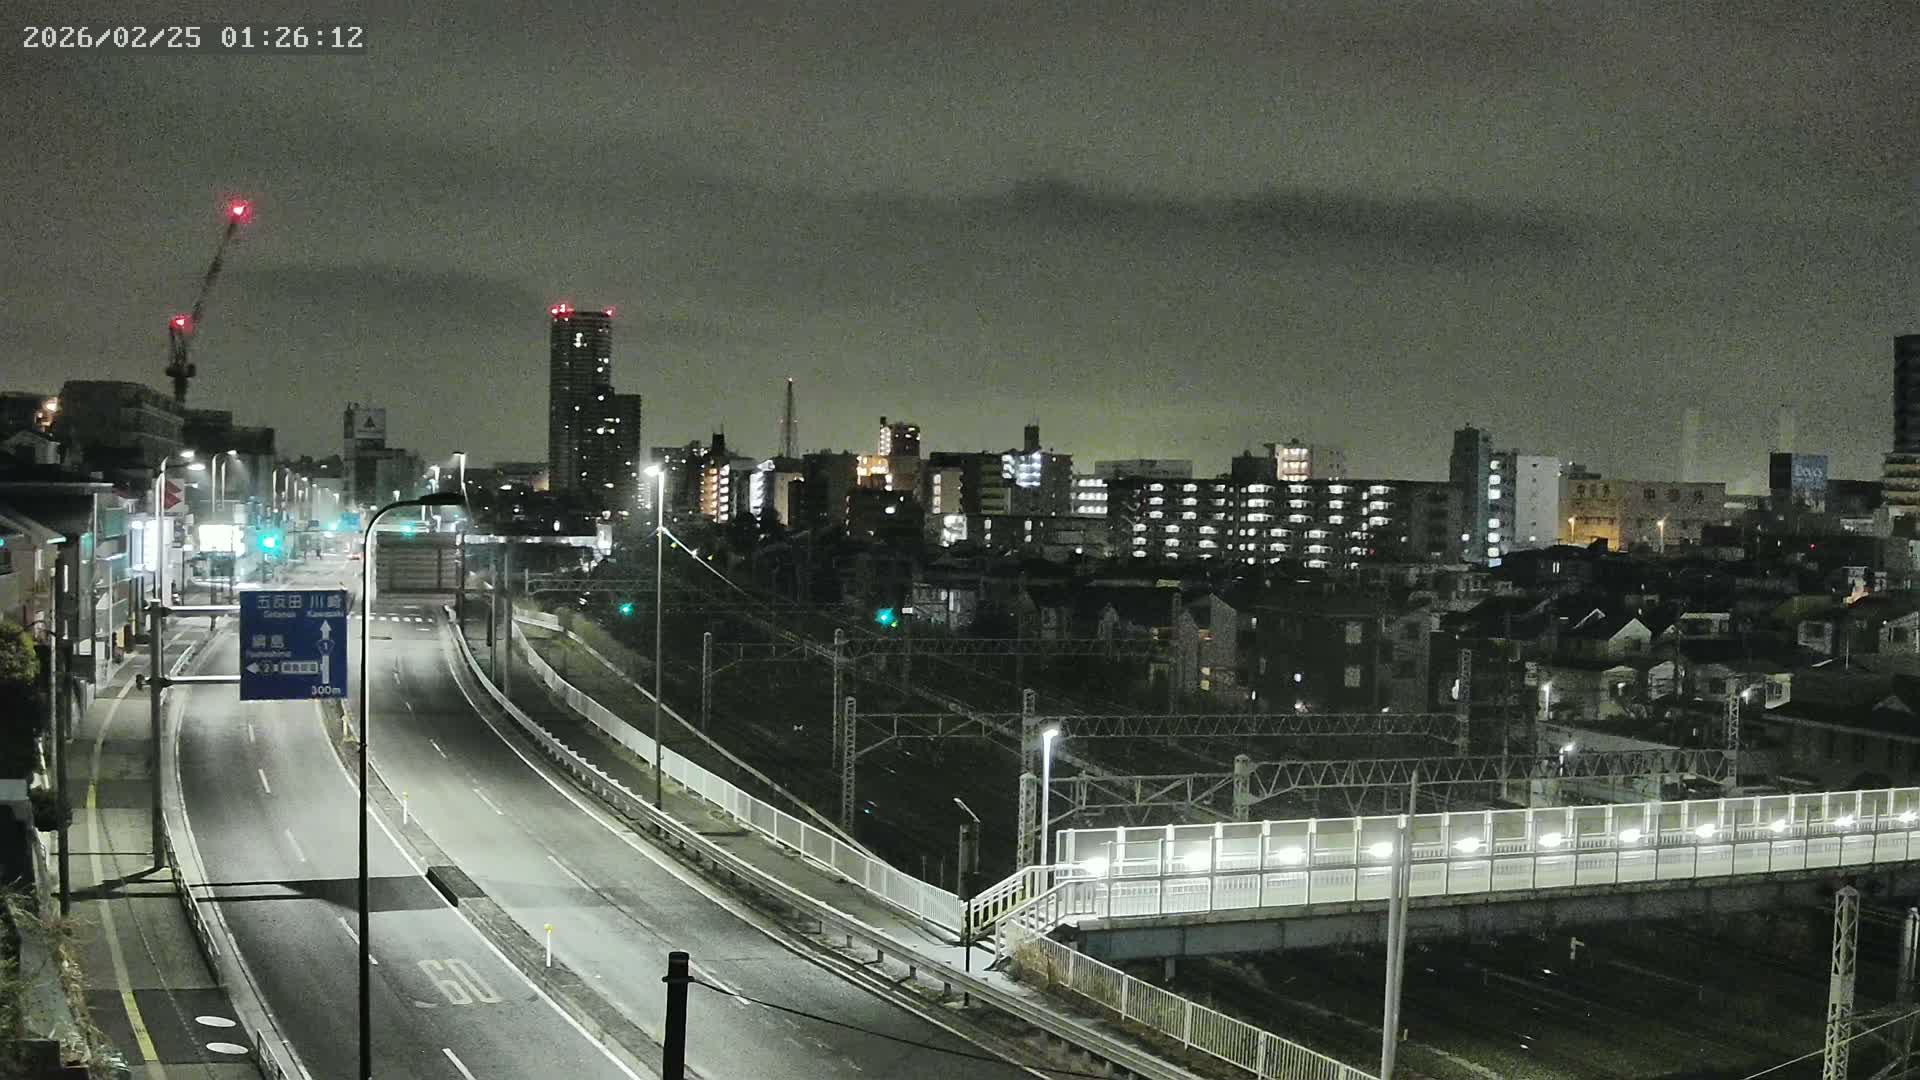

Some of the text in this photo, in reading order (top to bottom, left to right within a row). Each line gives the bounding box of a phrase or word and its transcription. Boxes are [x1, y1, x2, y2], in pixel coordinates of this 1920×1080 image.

[257, 595, 301, 608] 五反田
[311, 686, 341, 695] 300m
